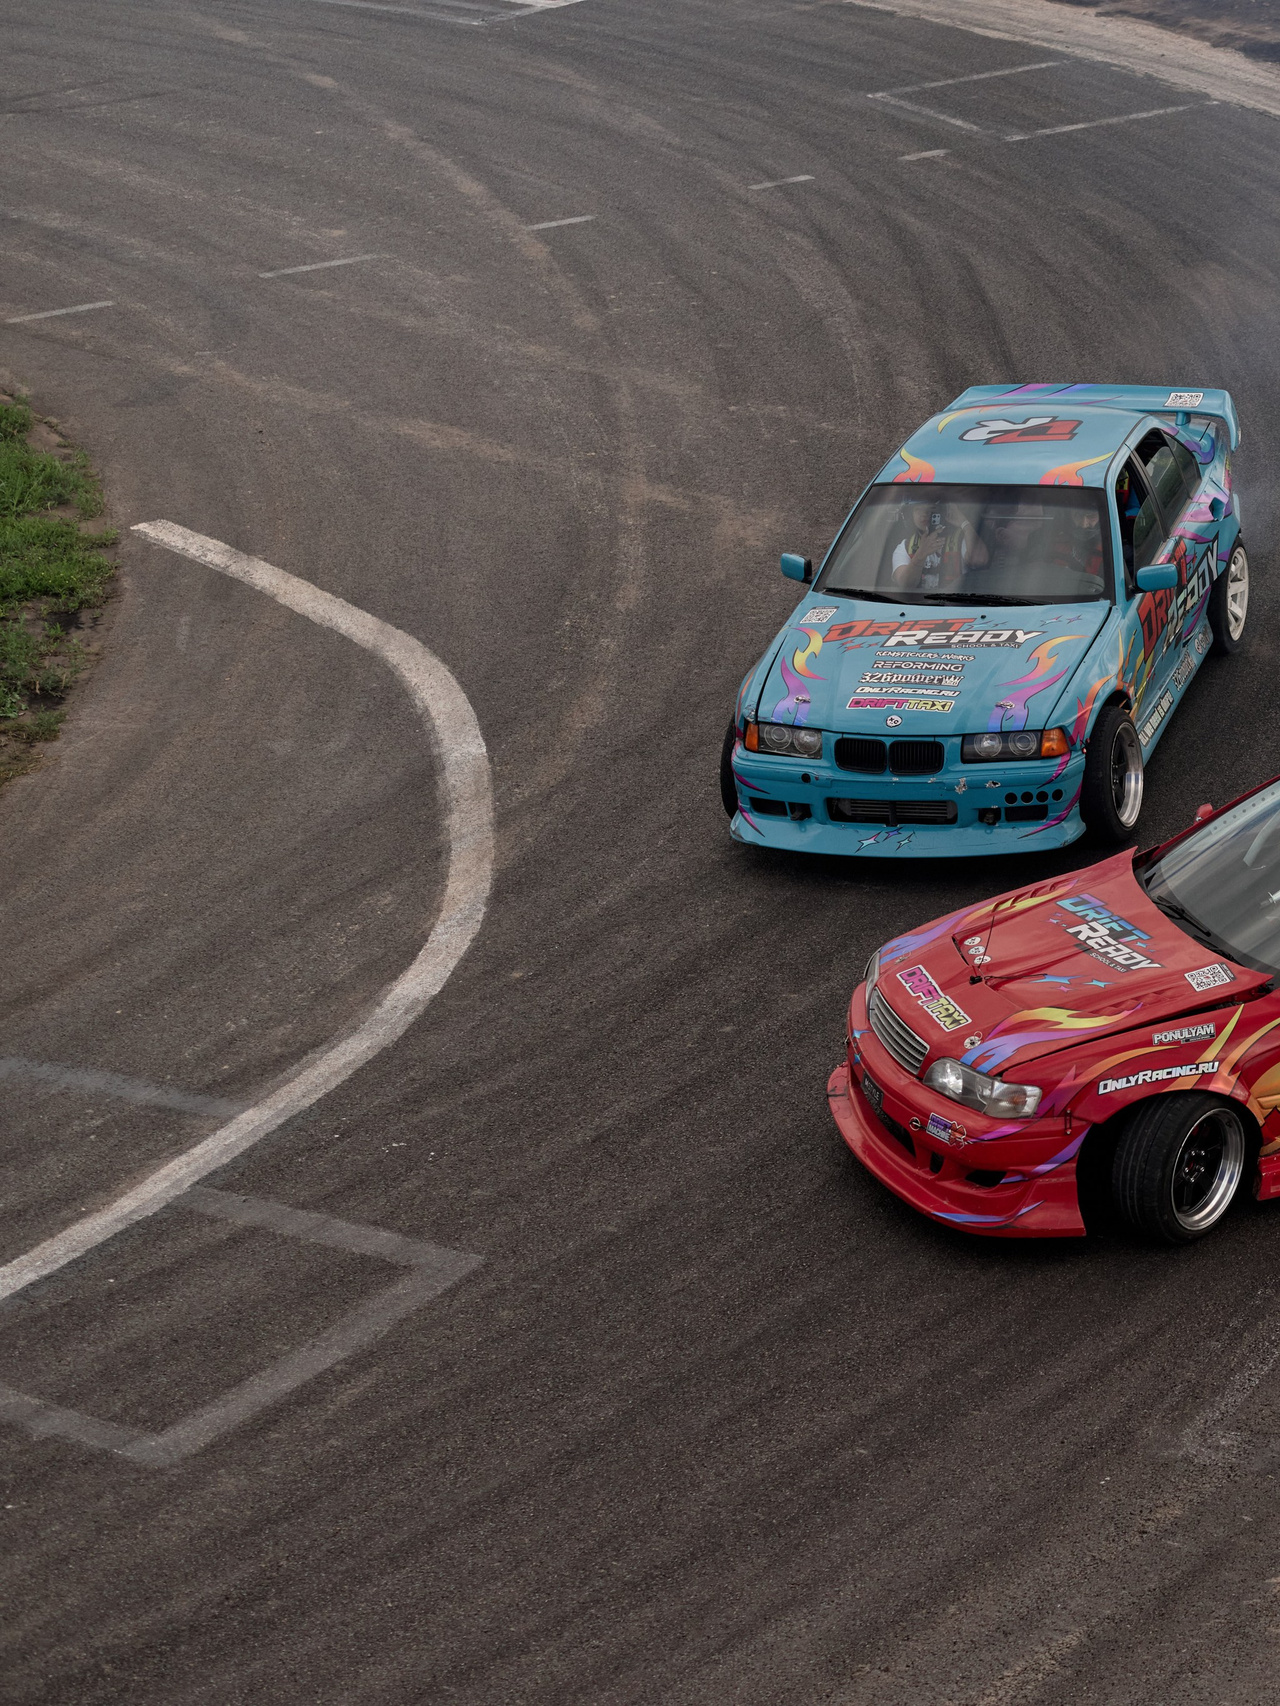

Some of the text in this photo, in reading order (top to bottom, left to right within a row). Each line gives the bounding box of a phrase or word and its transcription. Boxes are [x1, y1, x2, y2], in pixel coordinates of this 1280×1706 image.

[884, 630, 1046, 648] READY
[1066, 920, 1162, 970] READY
[1153, 1023, 1215, 1045] PONULYAM
